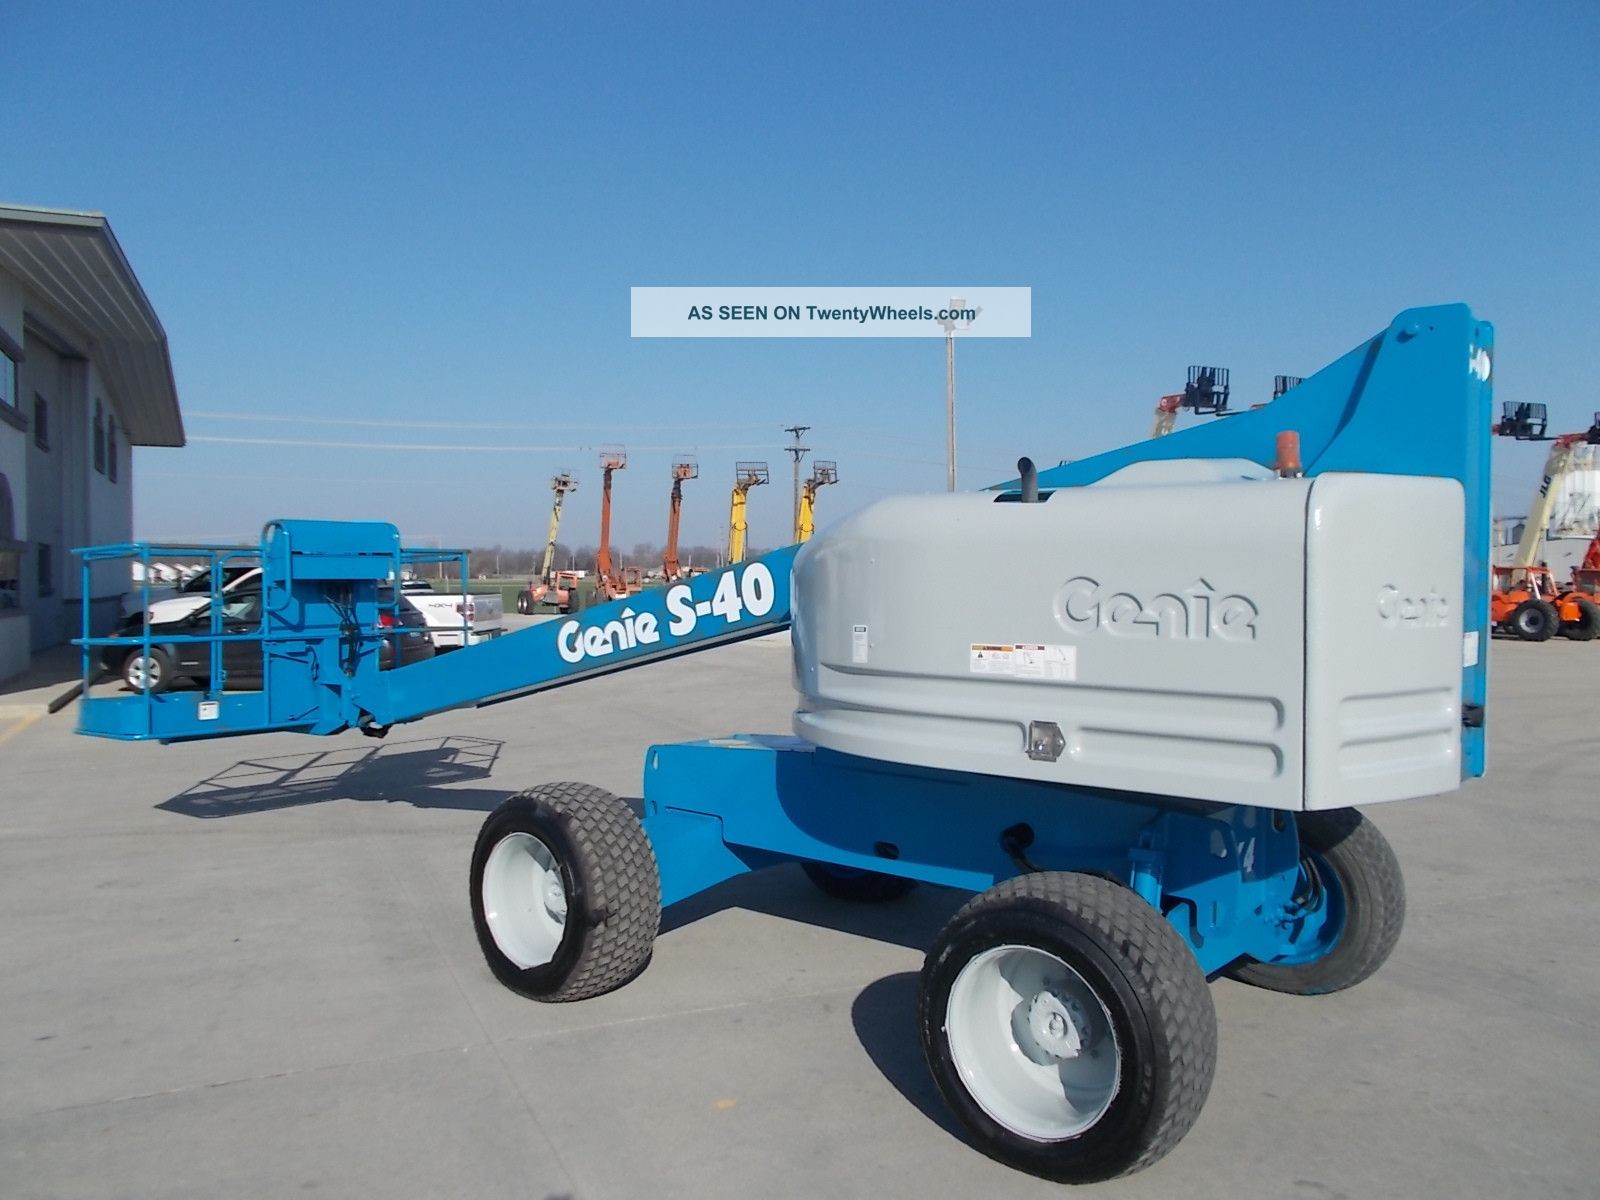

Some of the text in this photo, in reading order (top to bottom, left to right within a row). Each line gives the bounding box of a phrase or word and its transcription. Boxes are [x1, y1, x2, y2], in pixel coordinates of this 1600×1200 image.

[557, 562, 775, 663] Genie S-40
[1053, 576, 1259, 640] Genie
